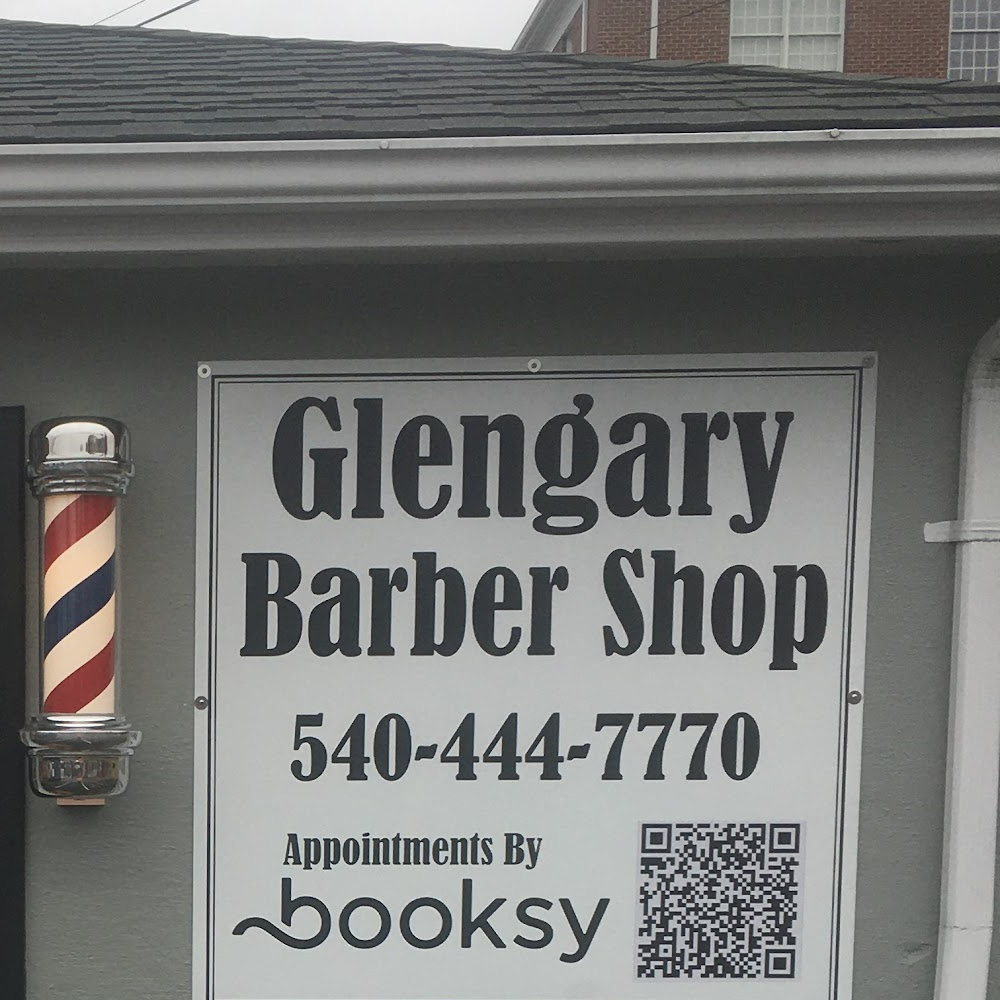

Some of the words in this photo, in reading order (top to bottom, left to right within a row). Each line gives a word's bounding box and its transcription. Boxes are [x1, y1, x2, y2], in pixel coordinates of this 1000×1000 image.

[272, 393, 795, 535] Glengary
[239, 552, 569, 657] Barber
[602, 548, 829, 670] Shop
[290, 712, 761, 782] 540-444-7770
[283, 833, 494, 872] Appointments
[503, 832, 543, 870] By
[232, 877, 611, 963] booksy
